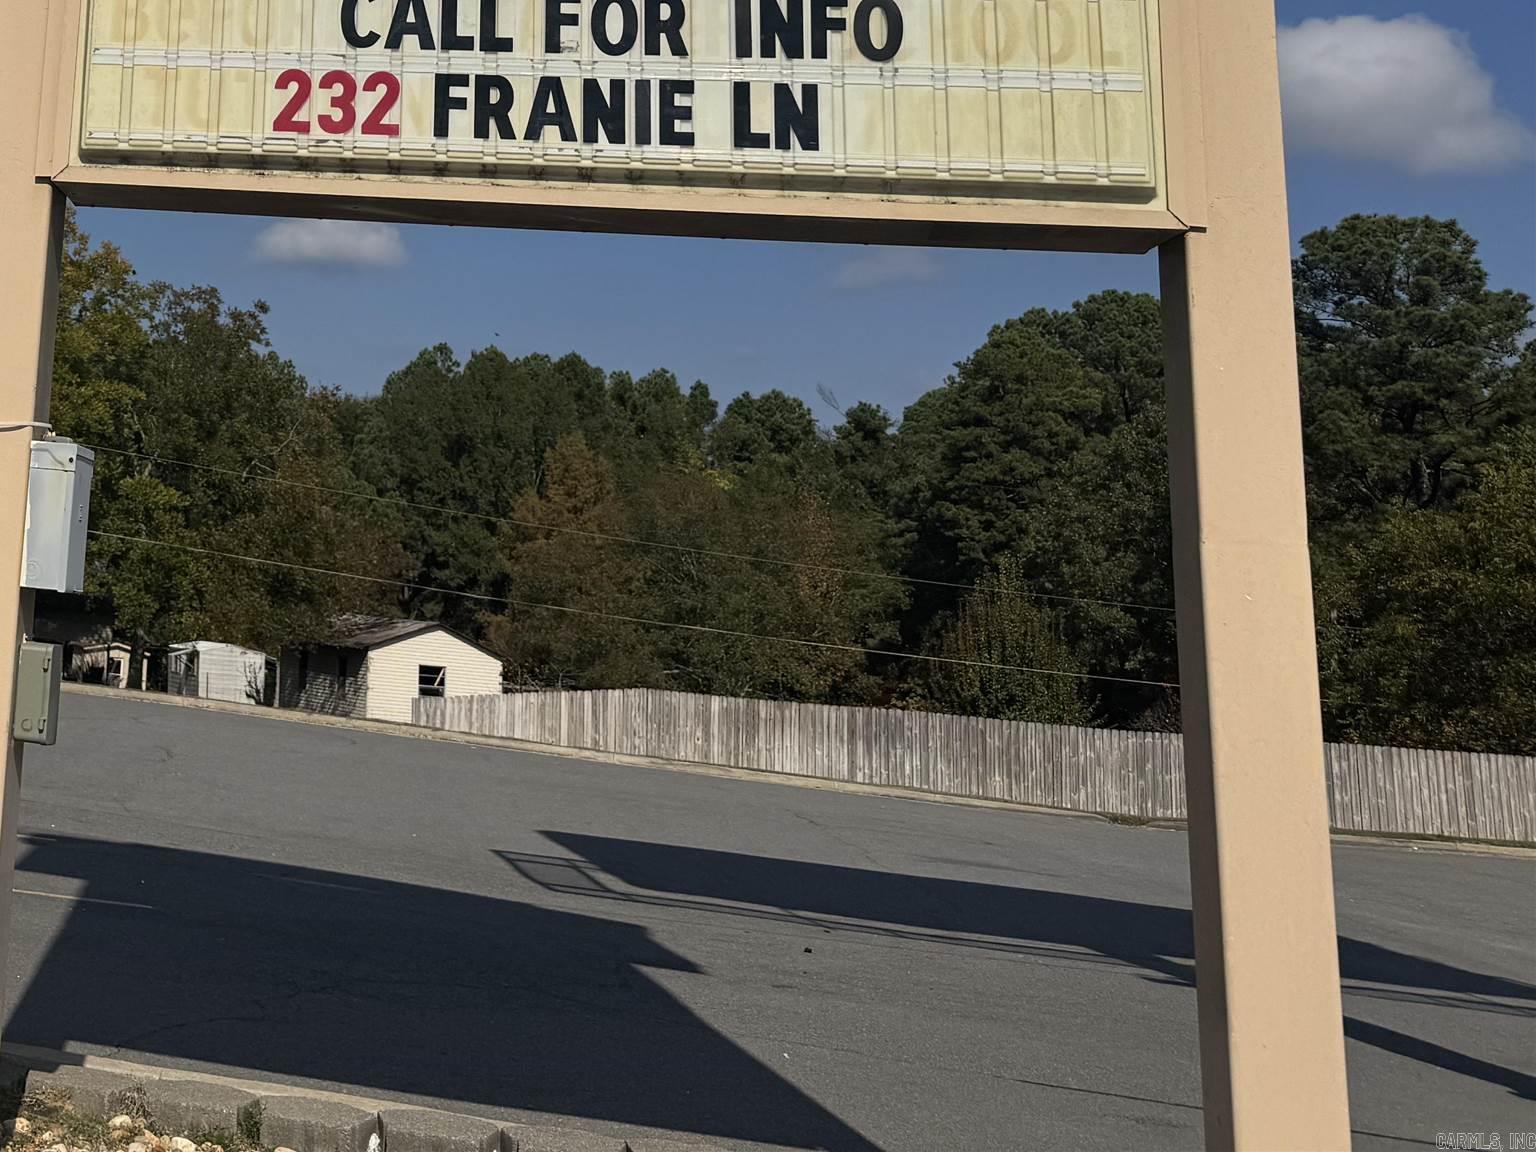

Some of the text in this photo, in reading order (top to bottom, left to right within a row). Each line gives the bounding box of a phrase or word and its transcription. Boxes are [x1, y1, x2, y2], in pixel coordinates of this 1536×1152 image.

[272, 68, 820, 151] 232 FRANIE LN
